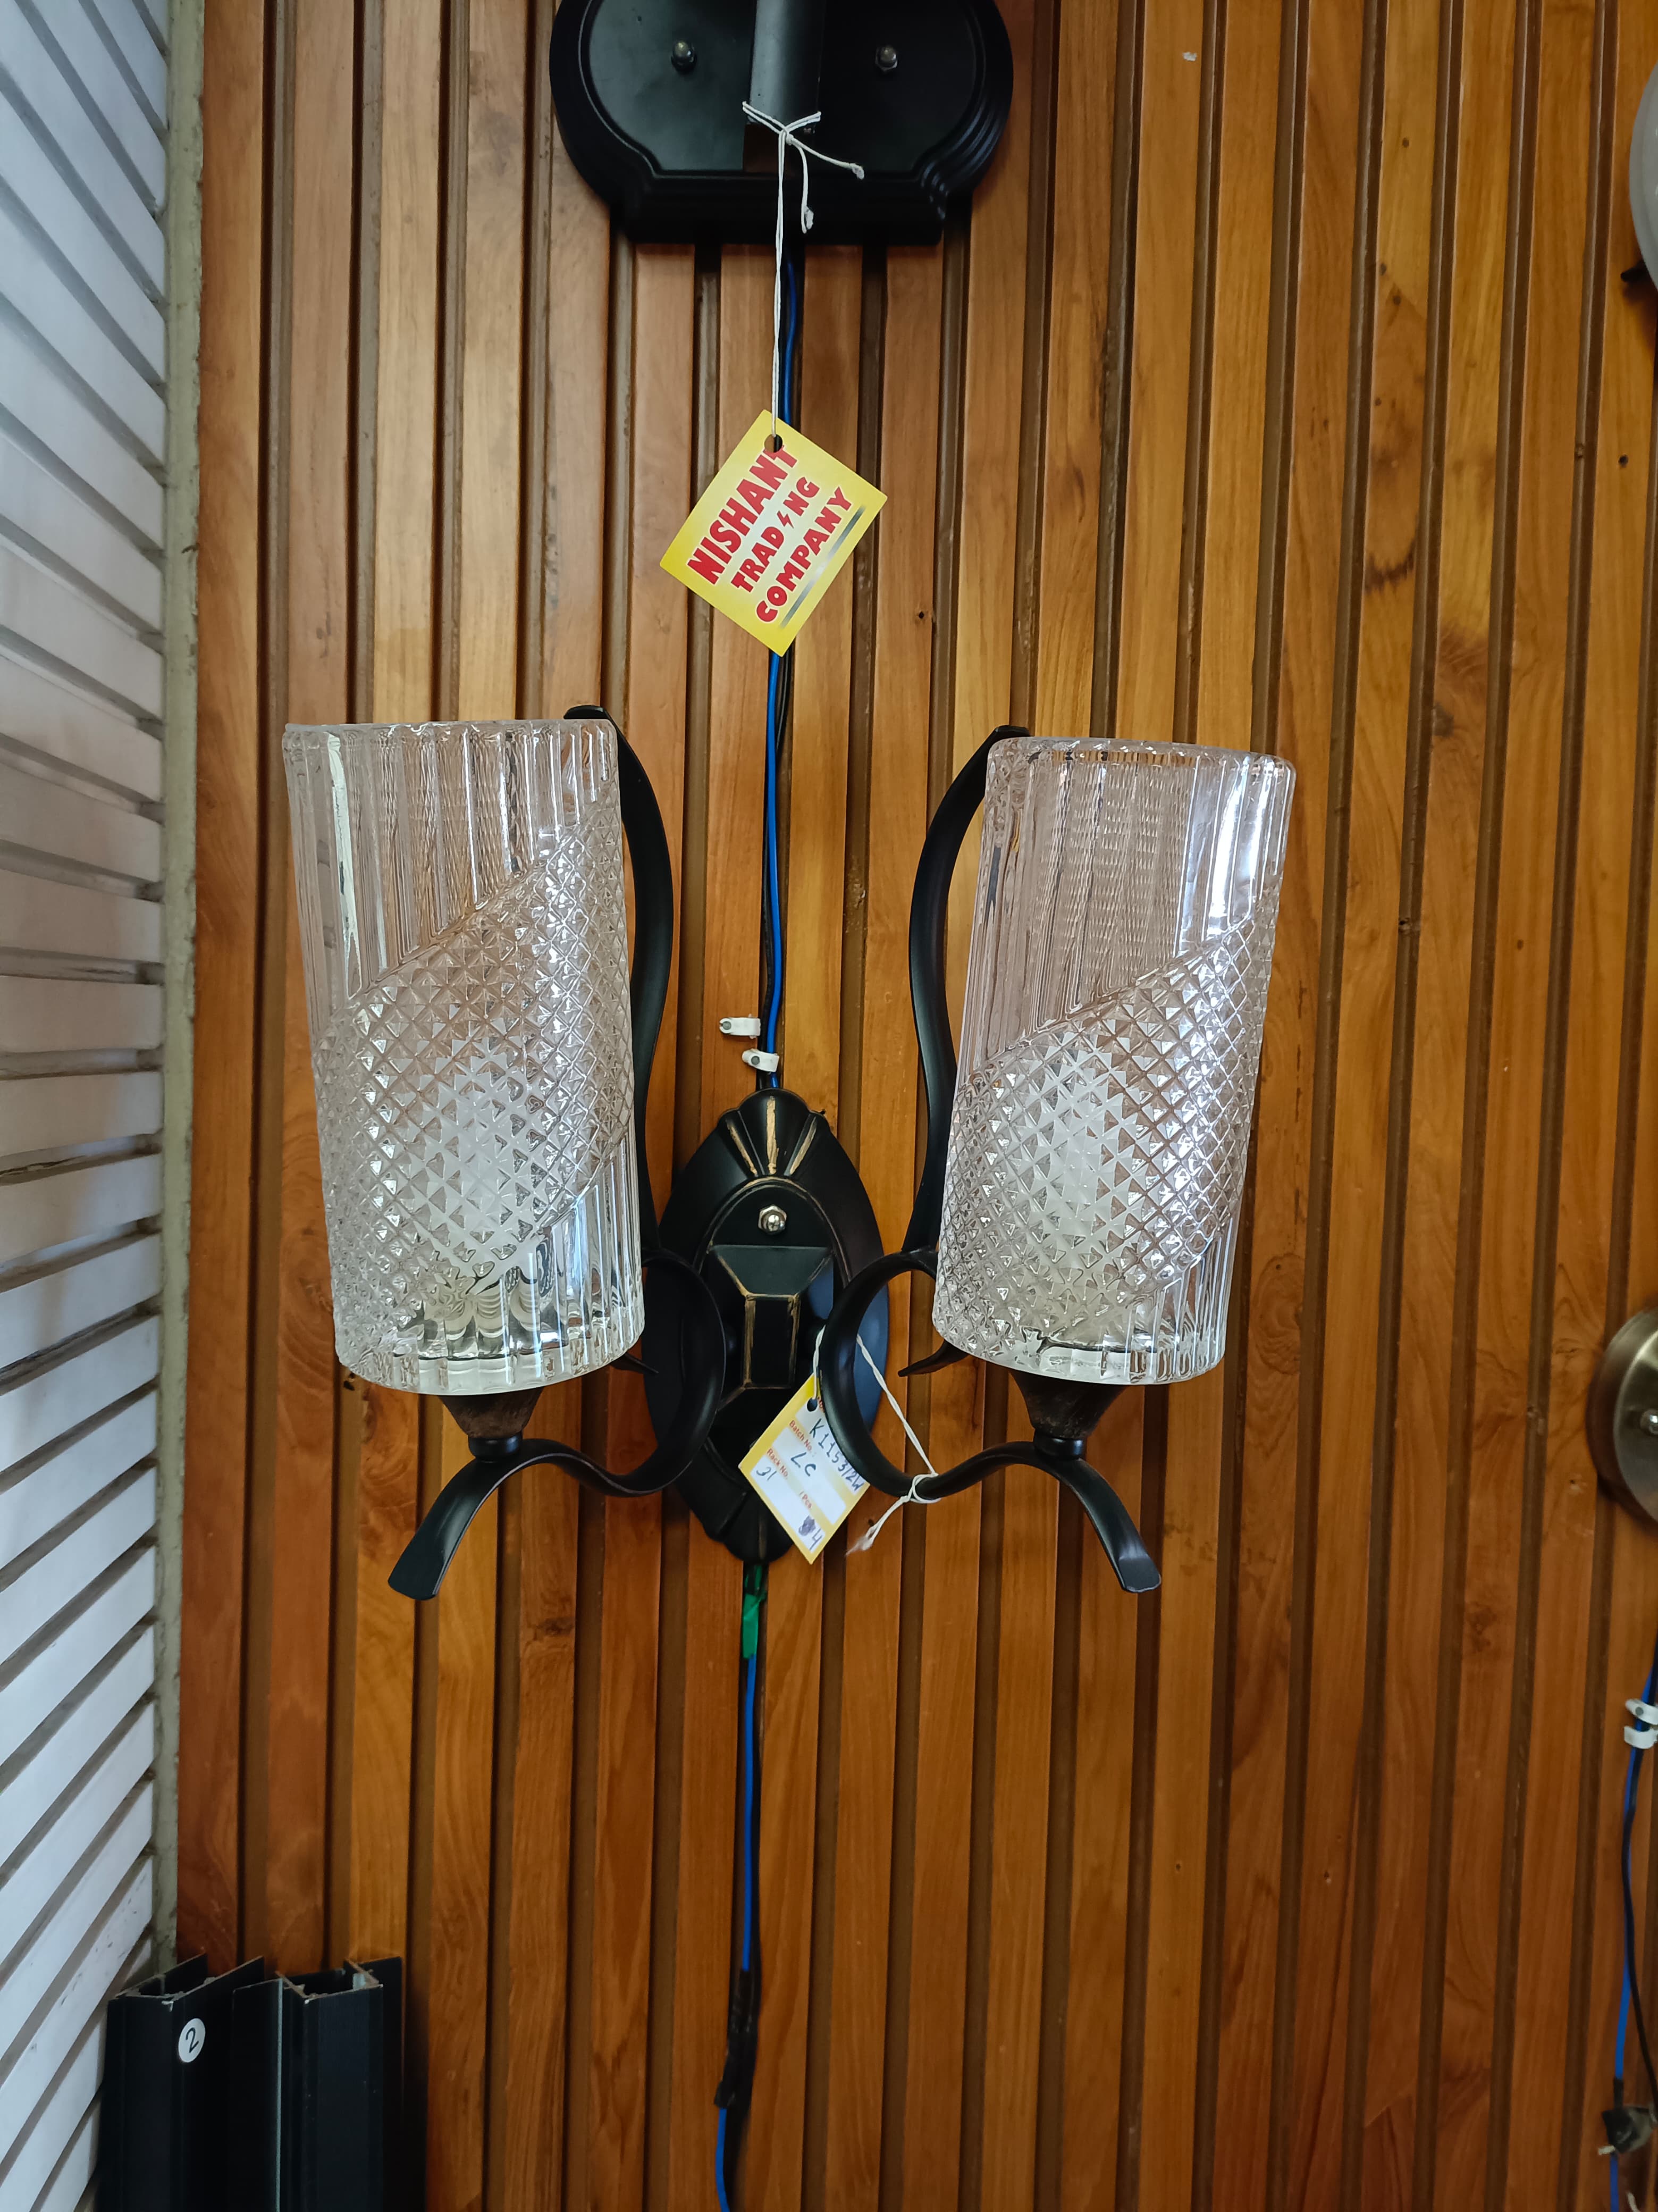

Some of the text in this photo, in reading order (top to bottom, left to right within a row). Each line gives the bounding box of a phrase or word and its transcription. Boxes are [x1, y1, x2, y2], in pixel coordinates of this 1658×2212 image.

[687, 445, 797, 585] NISHANT
[756, 487, 852, 622] COMPANY
[789, 1420, 805, 1442] Batch
[767, 1448, 781, 1467] Rack
[186, 2027, 199, 2054] 2
